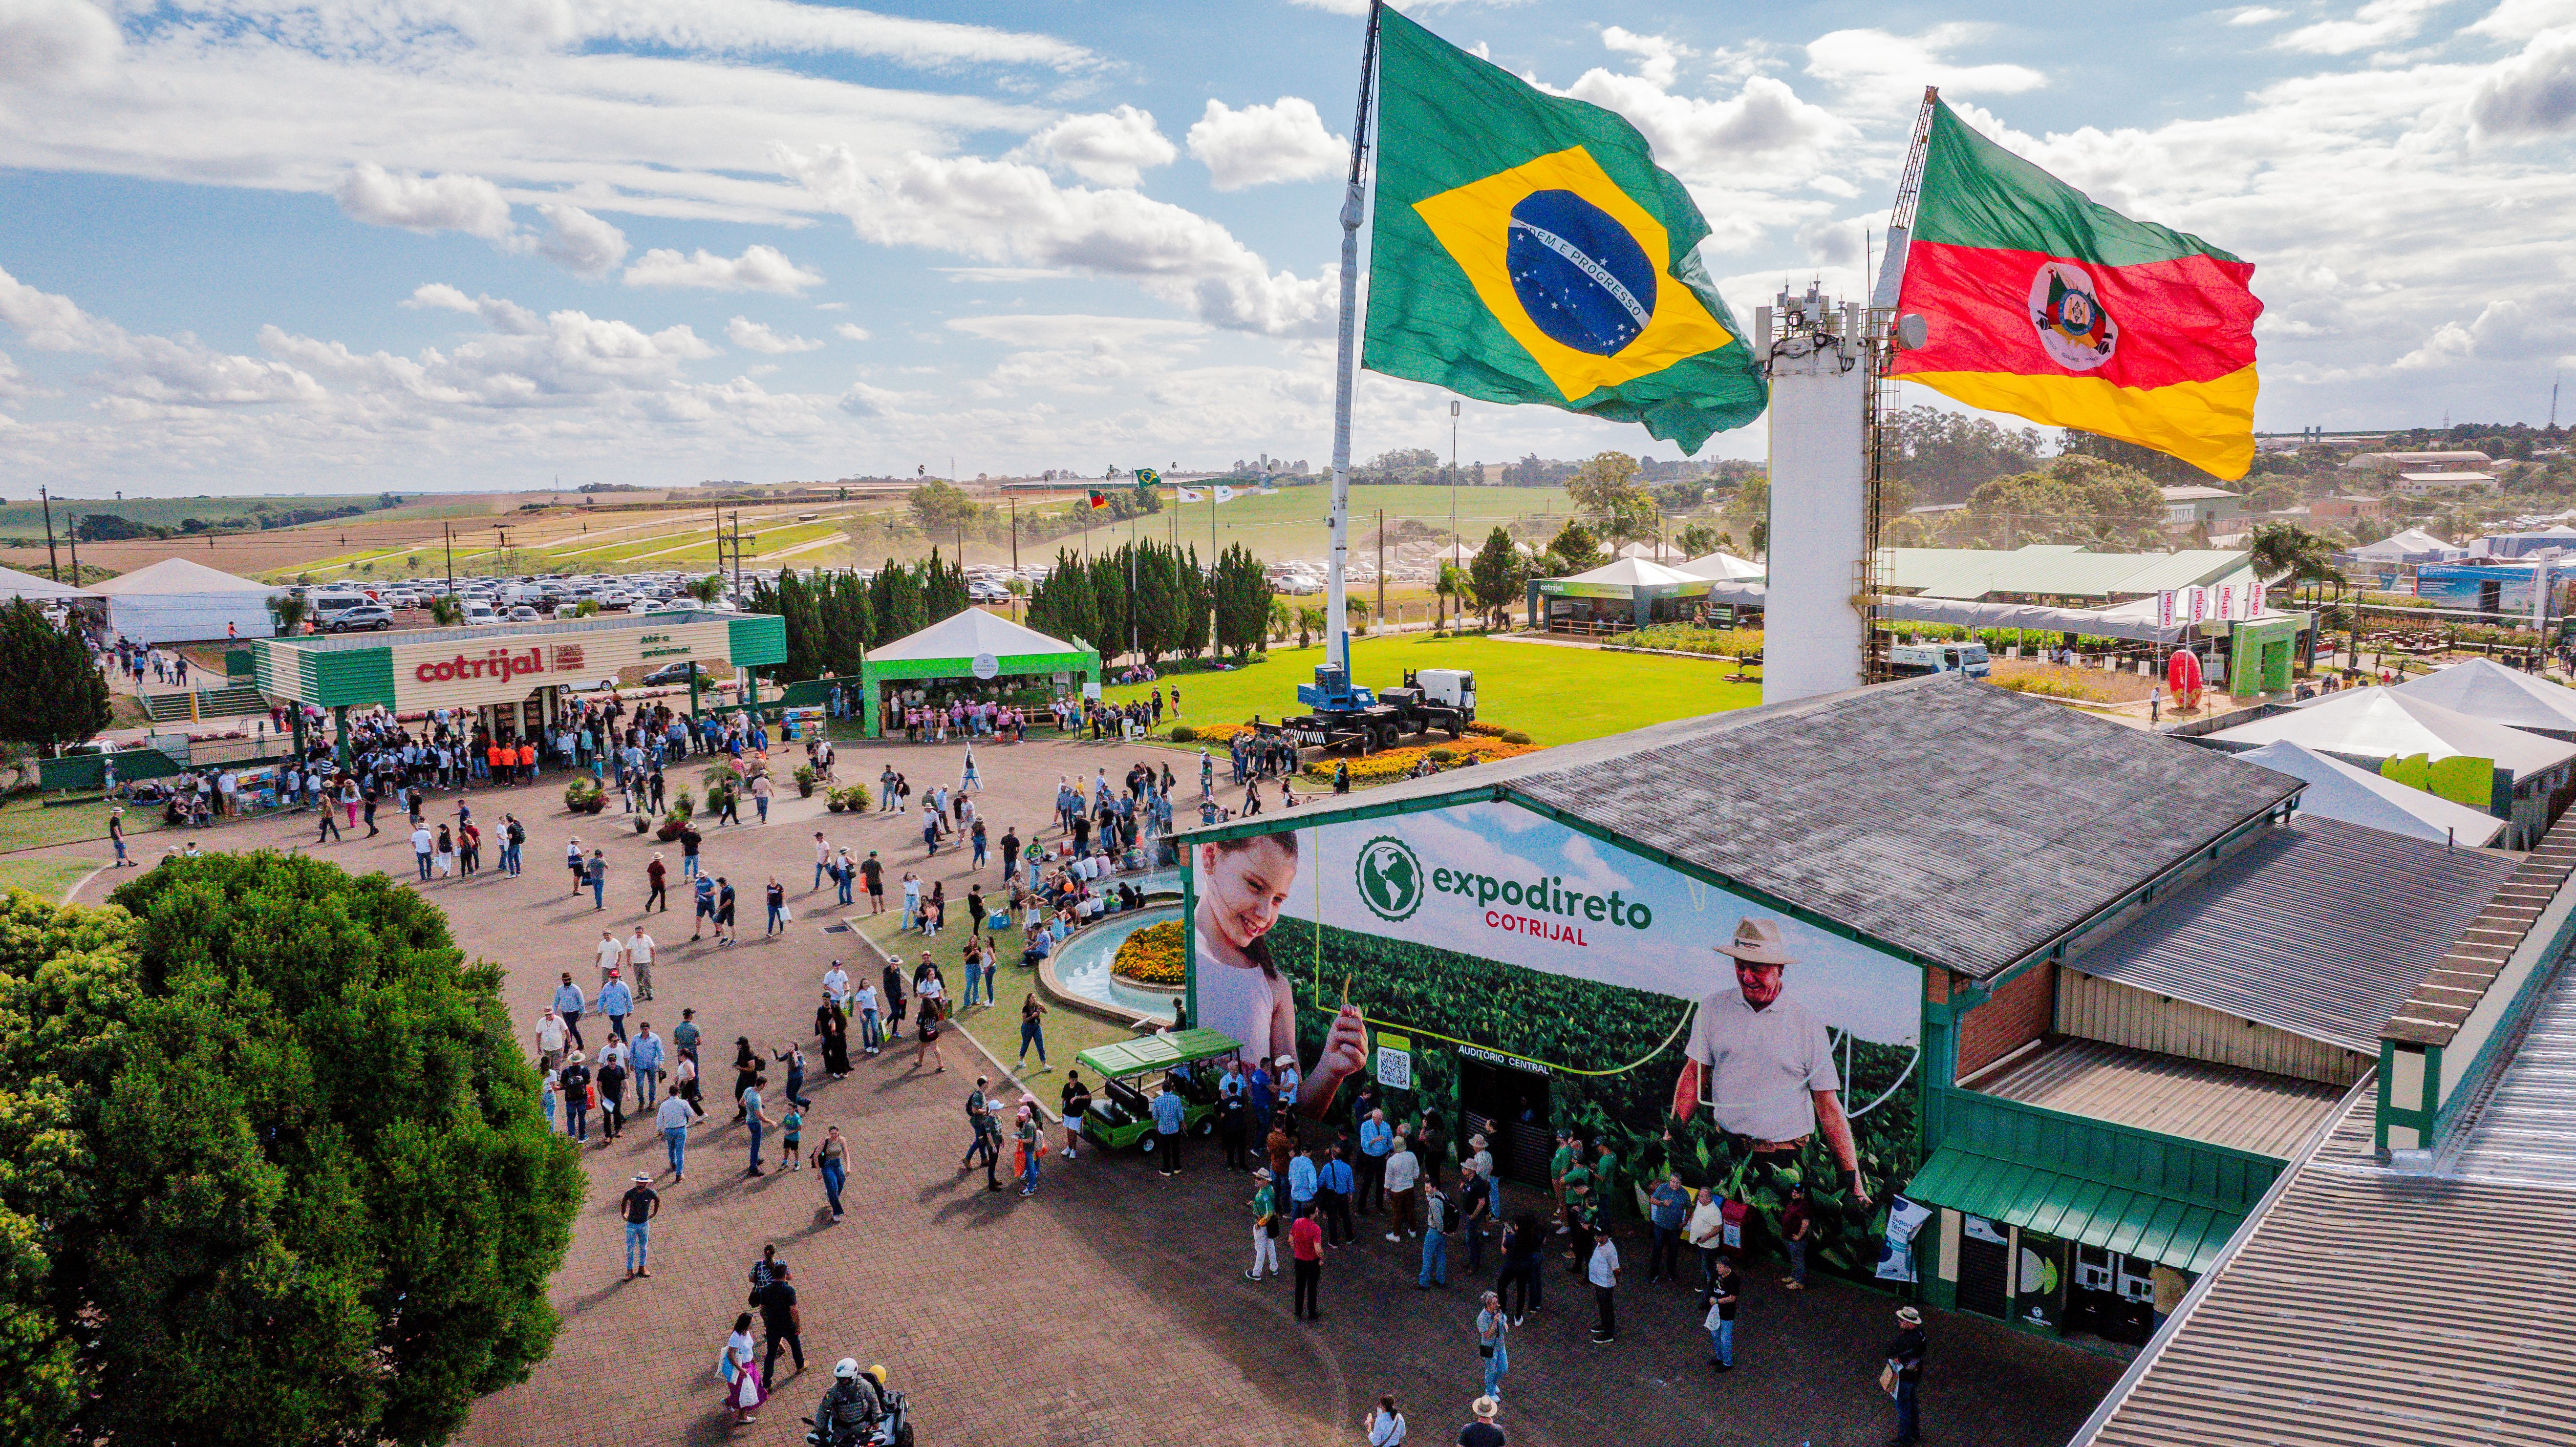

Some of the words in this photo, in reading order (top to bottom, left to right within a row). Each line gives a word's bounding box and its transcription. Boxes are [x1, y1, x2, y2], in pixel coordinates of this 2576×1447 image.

[1523, 224, 1556, 247] DEM
[1559, 243, 1568, 254] E
[1570, 250, 1641, 317] PROGRESSO
[1540, 583, 1564, 593] cotrijal
[2221, 587, 2231, 619] cotrijal
[2252, 584, 2261, 615] cotrijal
[641, 633, 660, 643] Até
[642, 646, 691, 659] próxima!
[416, 647, 544, 683] cotrijal
[1433, 868, 1652, 929] expodireto
[1485, 911, 1588, 947] COTRIJAL
[1458, 1044, 1504, 1064] AUDITÓRIO
[1508, 1057, 1549, 1075] CENTRAL
